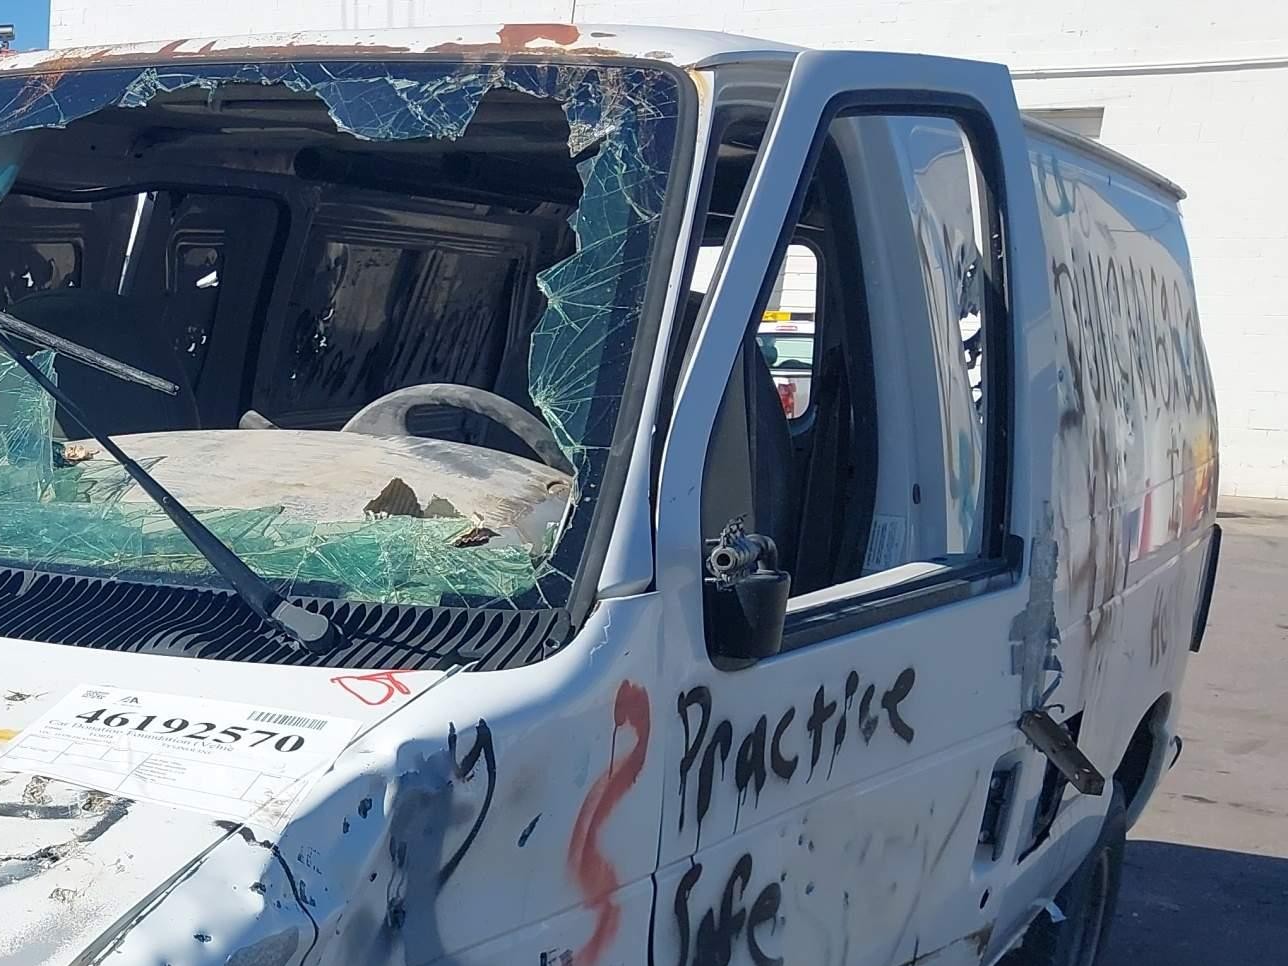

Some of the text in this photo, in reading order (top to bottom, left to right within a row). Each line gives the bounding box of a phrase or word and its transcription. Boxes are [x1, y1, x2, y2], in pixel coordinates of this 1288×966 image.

[72, 722, 123, 735] Donation
[126, 730, 192, 746] Foundation
[74, 708, 305, 753] 46192570
[676, 667, 916, 824] Practice
